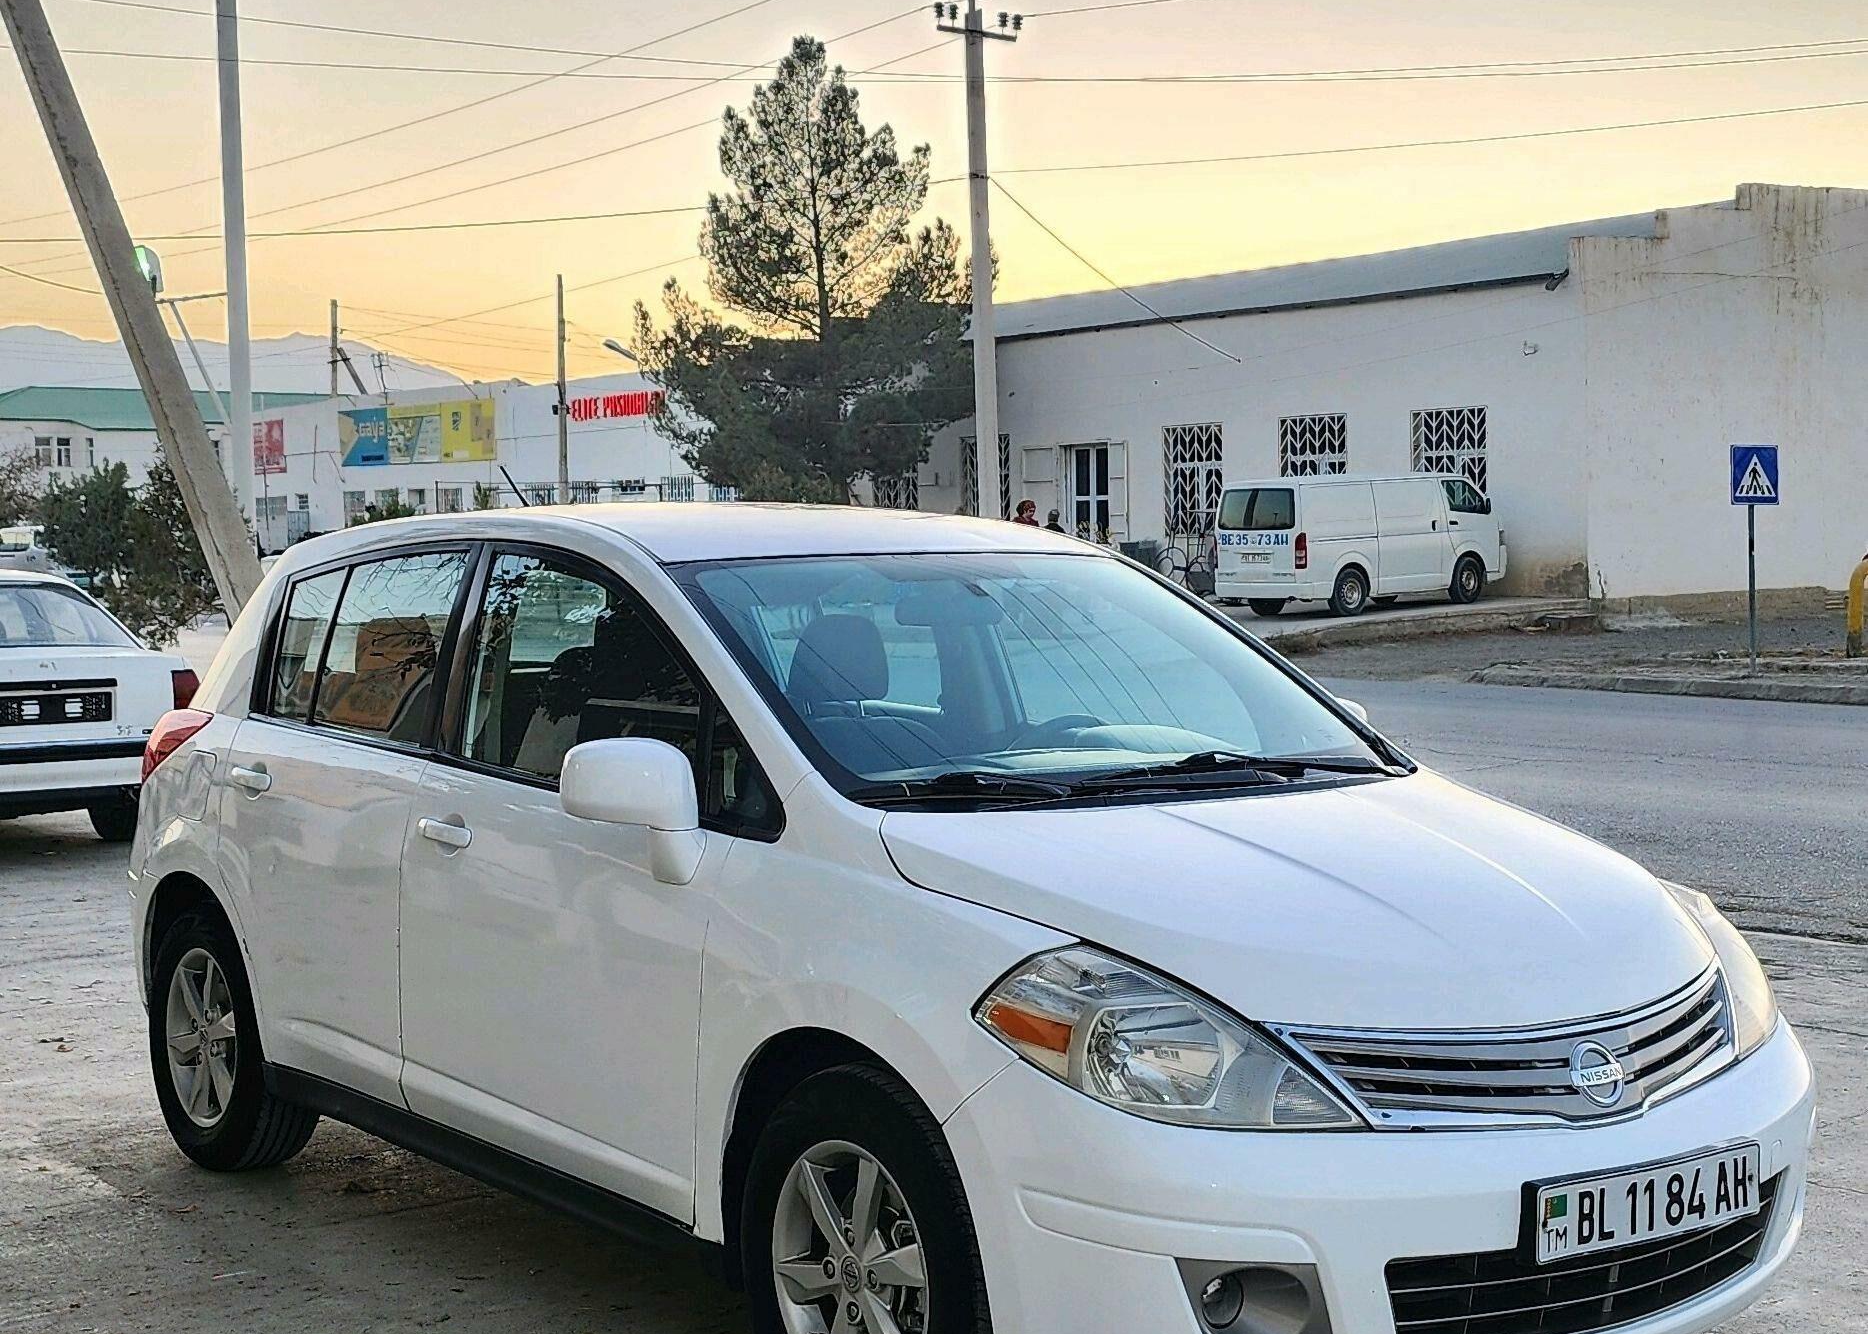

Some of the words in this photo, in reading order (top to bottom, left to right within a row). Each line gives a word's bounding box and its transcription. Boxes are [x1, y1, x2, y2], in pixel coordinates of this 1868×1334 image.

[571, 397, 600, 422] ELITE
[1580, 1066, 1622, 1083] NISSAN
[1577, 1187, 1615, 1246] BL
[1714, 1155, 1749, 1215] AH
[1543, 1225, 1568, 1253] TM
